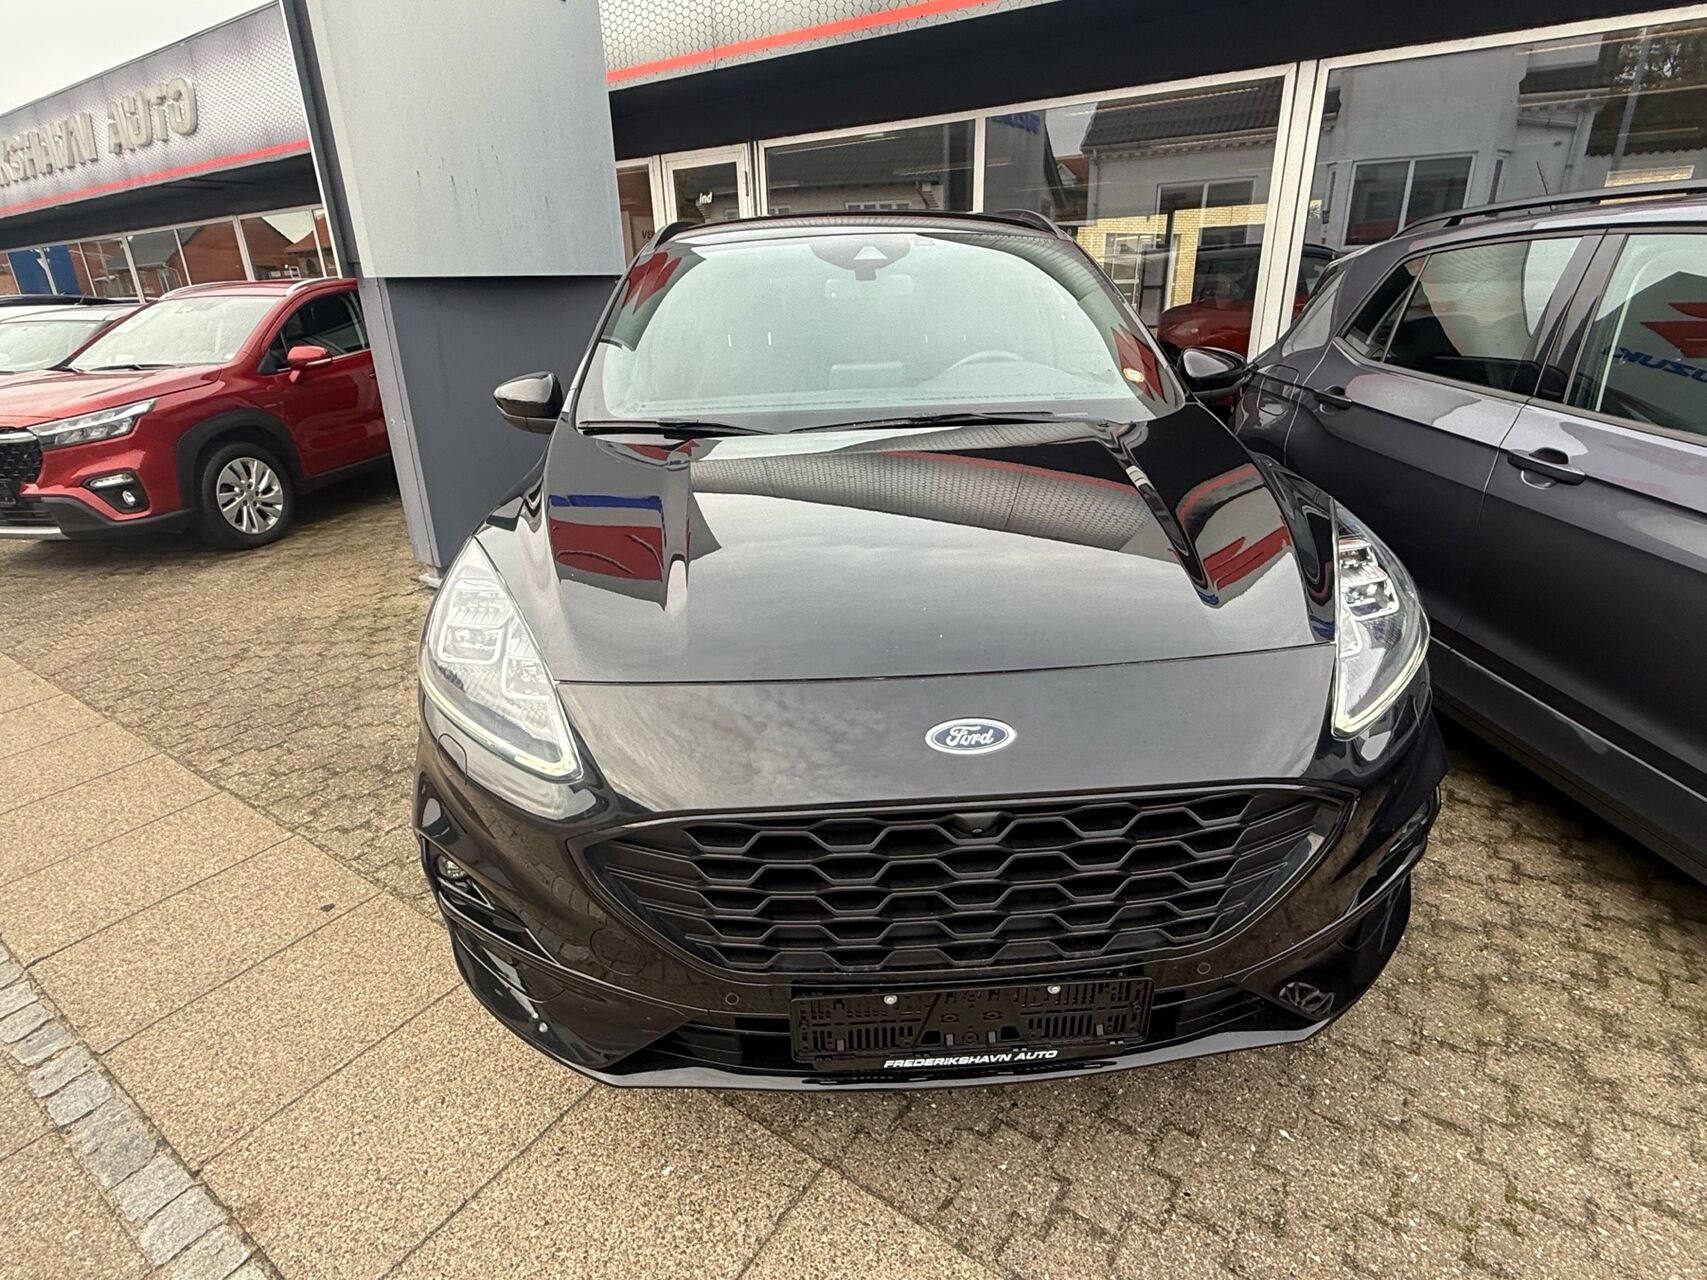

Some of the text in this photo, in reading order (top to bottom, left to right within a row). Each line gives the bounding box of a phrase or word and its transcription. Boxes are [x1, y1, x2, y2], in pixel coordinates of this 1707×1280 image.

[106, 77, 199, 154] AUTO
[945, 725, 994, 746] Ford
[883, 1050, 1058, 1069] FREDERIKSHAVN AUTO
